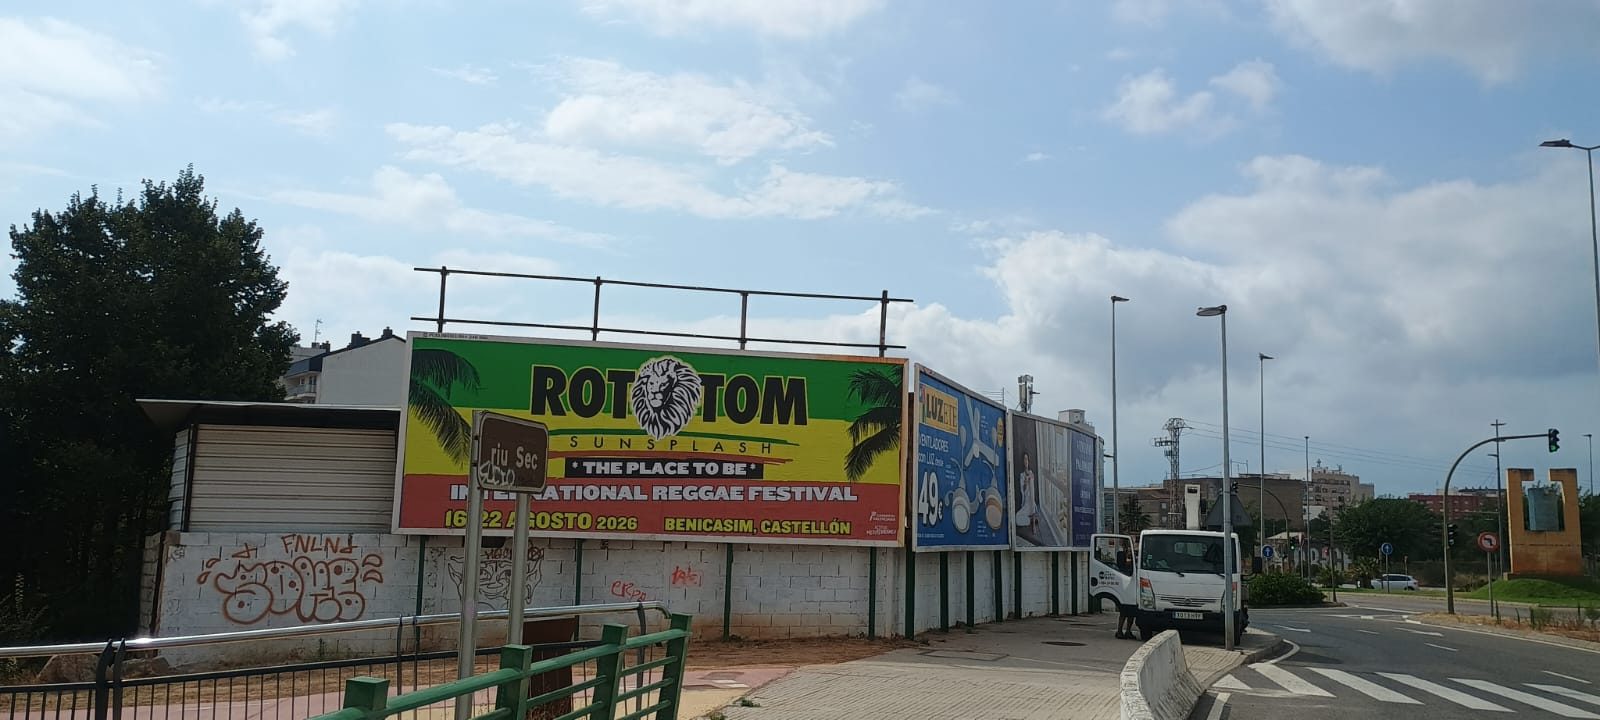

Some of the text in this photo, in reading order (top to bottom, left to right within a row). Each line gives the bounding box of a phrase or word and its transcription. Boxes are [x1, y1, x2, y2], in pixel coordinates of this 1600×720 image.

[569, 436, 770, 454] SUNSPLASH
[491, 442, 538, 470] riu Sec
[583, 462, 747, 476] THE PLACE TO BE
[451, 484, 858, 501] INEATIONAL REGGAE FESTIVAL
[597, 517, 638, 530] 2026
[664, 517, 757, 535] BENICASIM,
[760, 518, 851, 535] CASTELLÓN
